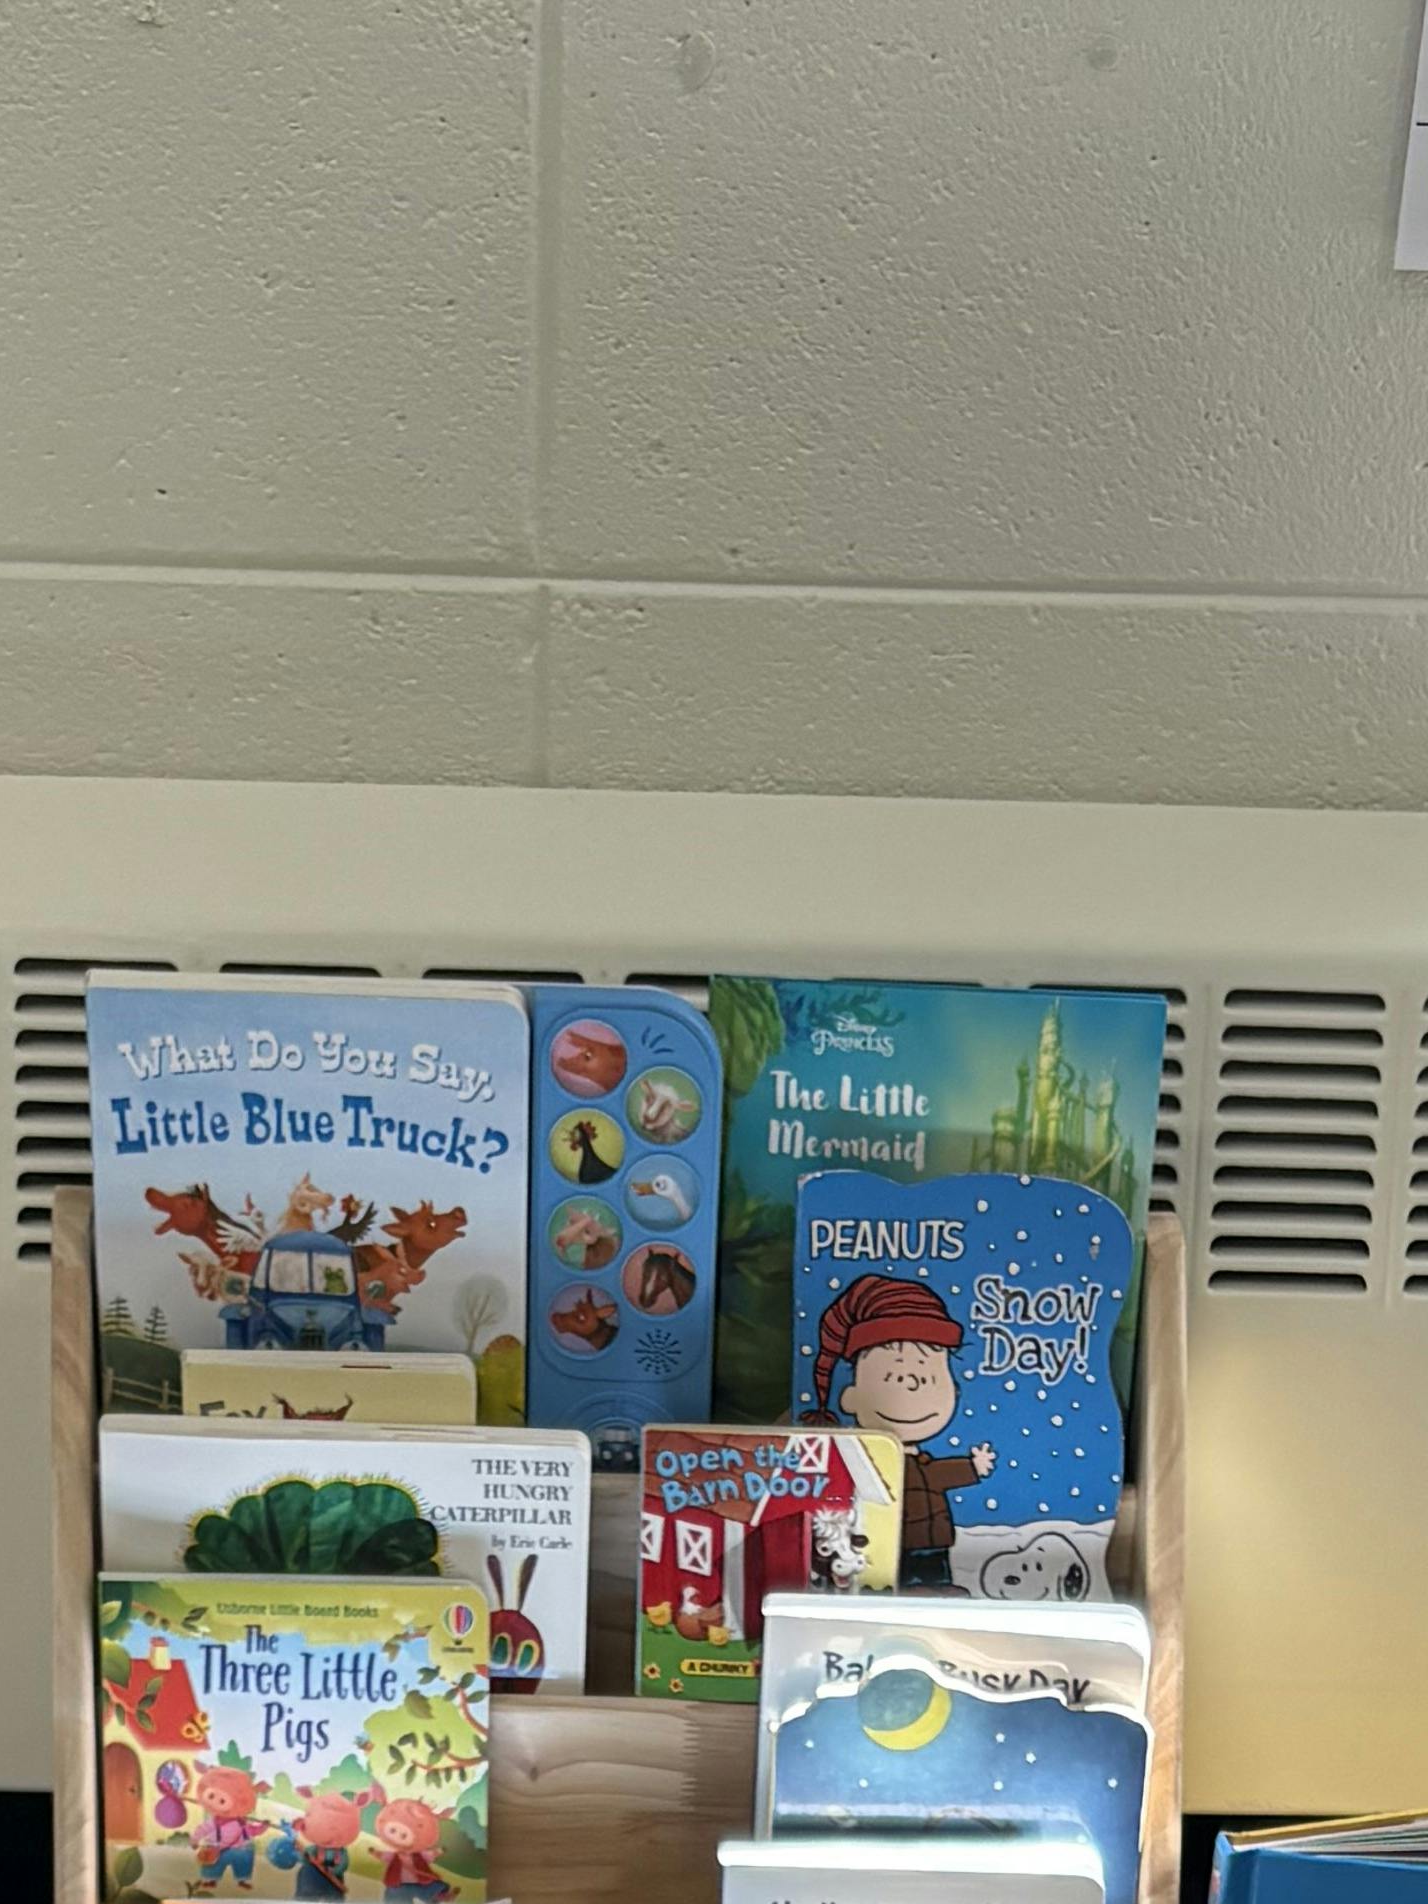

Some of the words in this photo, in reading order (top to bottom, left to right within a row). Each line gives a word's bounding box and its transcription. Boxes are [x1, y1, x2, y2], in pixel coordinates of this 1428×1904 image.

[117, 1033, 235, 1081] What
[246, 1030, 305, 1072] Do
[313, 1031, 396, 1079] You
[408, 1043, 496, 1102] Say,
[770, 1070, 830, 1112] The
[839, 1074, 930, 1119] Little
[111, 1096, 230, 1155] Little
[241, 1092, 335, 1147] Blue
[342, 1094, 509, 1174] Truck?
[768, 1119, 926, 1172] Mermaid
[810, 1219, 966, 1261] PEANUTS
[973, 1274, 1102, 1324] Snow
[980, 1324, 1091, 1386] Day!
[471, 1459, 517, 1475] THE
[520, 1460, 573, 1477] VERY
[655, 1447, 744, 1478] Open
[755, 1445, 800, 1469] the
[483, 1483, 572, 1502] HUNGRY
[661, 1475, 739, 1513] Barn
[743, 1471, 829, 1501] Door
[430, 1505, 572, 1525] CATERPILLAR
[492, 1534, 506, 1551] by
[510, 1535, 534, 1548] Eric
[539, 1536, 572, 1549] Carle
[245, 1625, 279, 1654] The
[199, 1644, 291, 1695] Three
[300, 1652, 398, 1702] Little
[261, 1702, 330, 1763] Pigs
